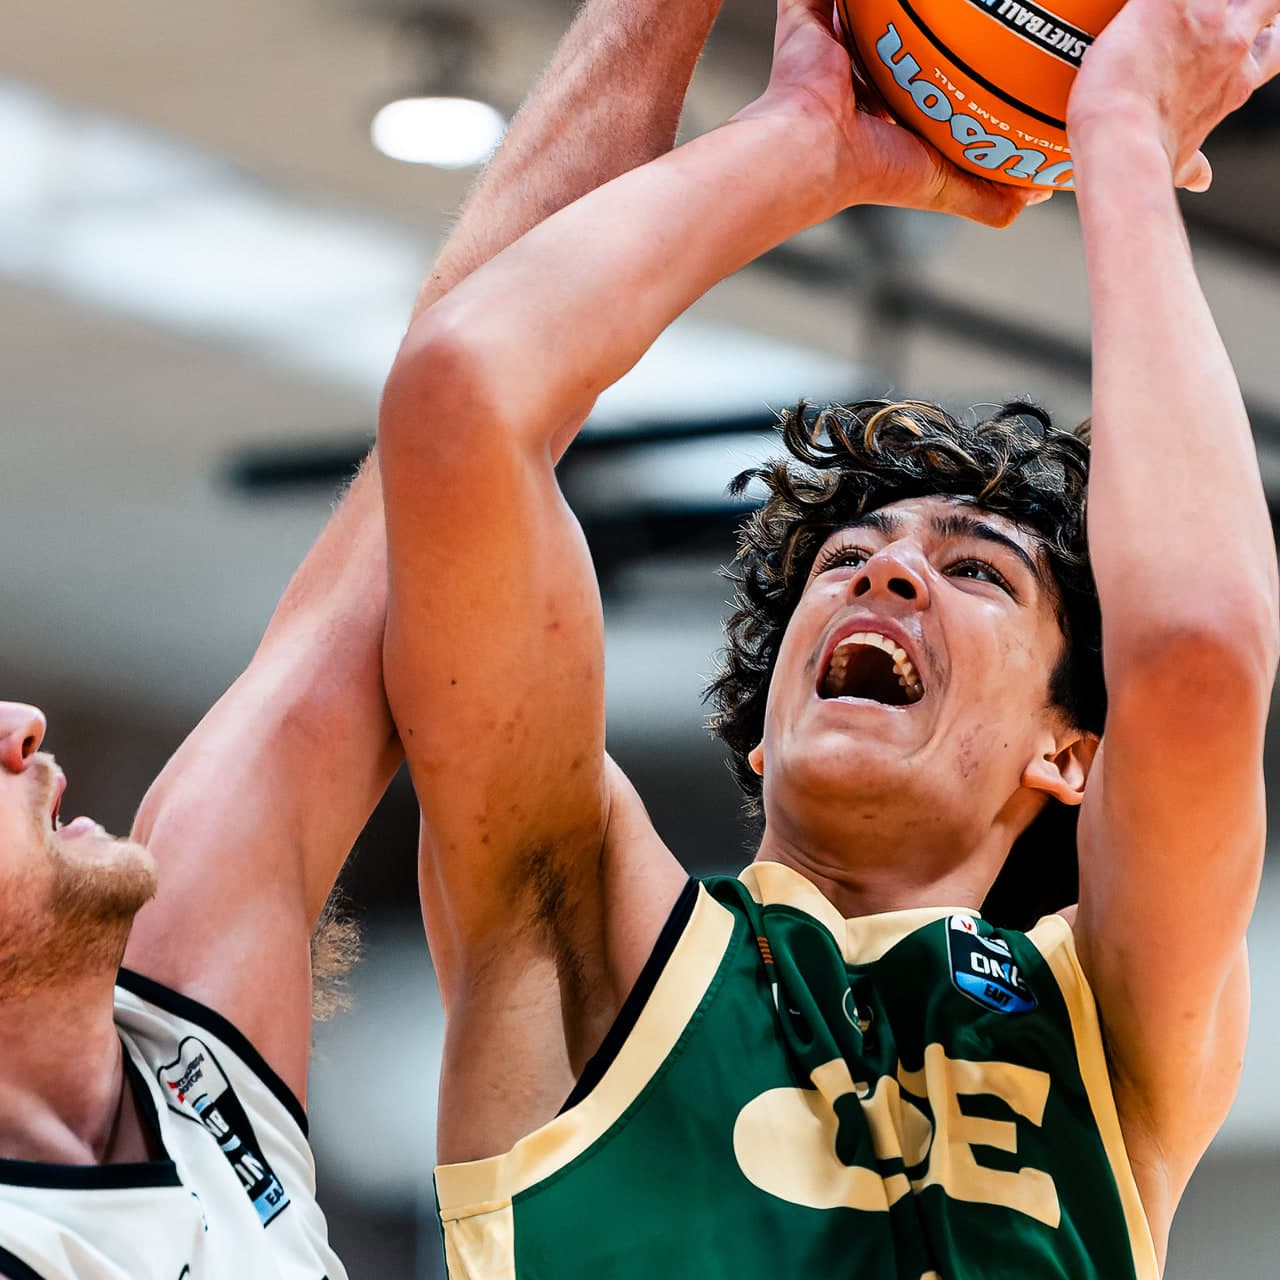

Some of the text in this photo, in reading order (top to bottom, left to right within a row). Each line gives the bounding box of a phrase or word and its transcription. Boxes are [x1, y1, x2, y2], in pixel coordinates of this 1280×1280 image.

[998, 0, 1091, 60] SKETBALL
[934, 67, 966, 101] BALL
[967, 101, 1011, 132] GAME
